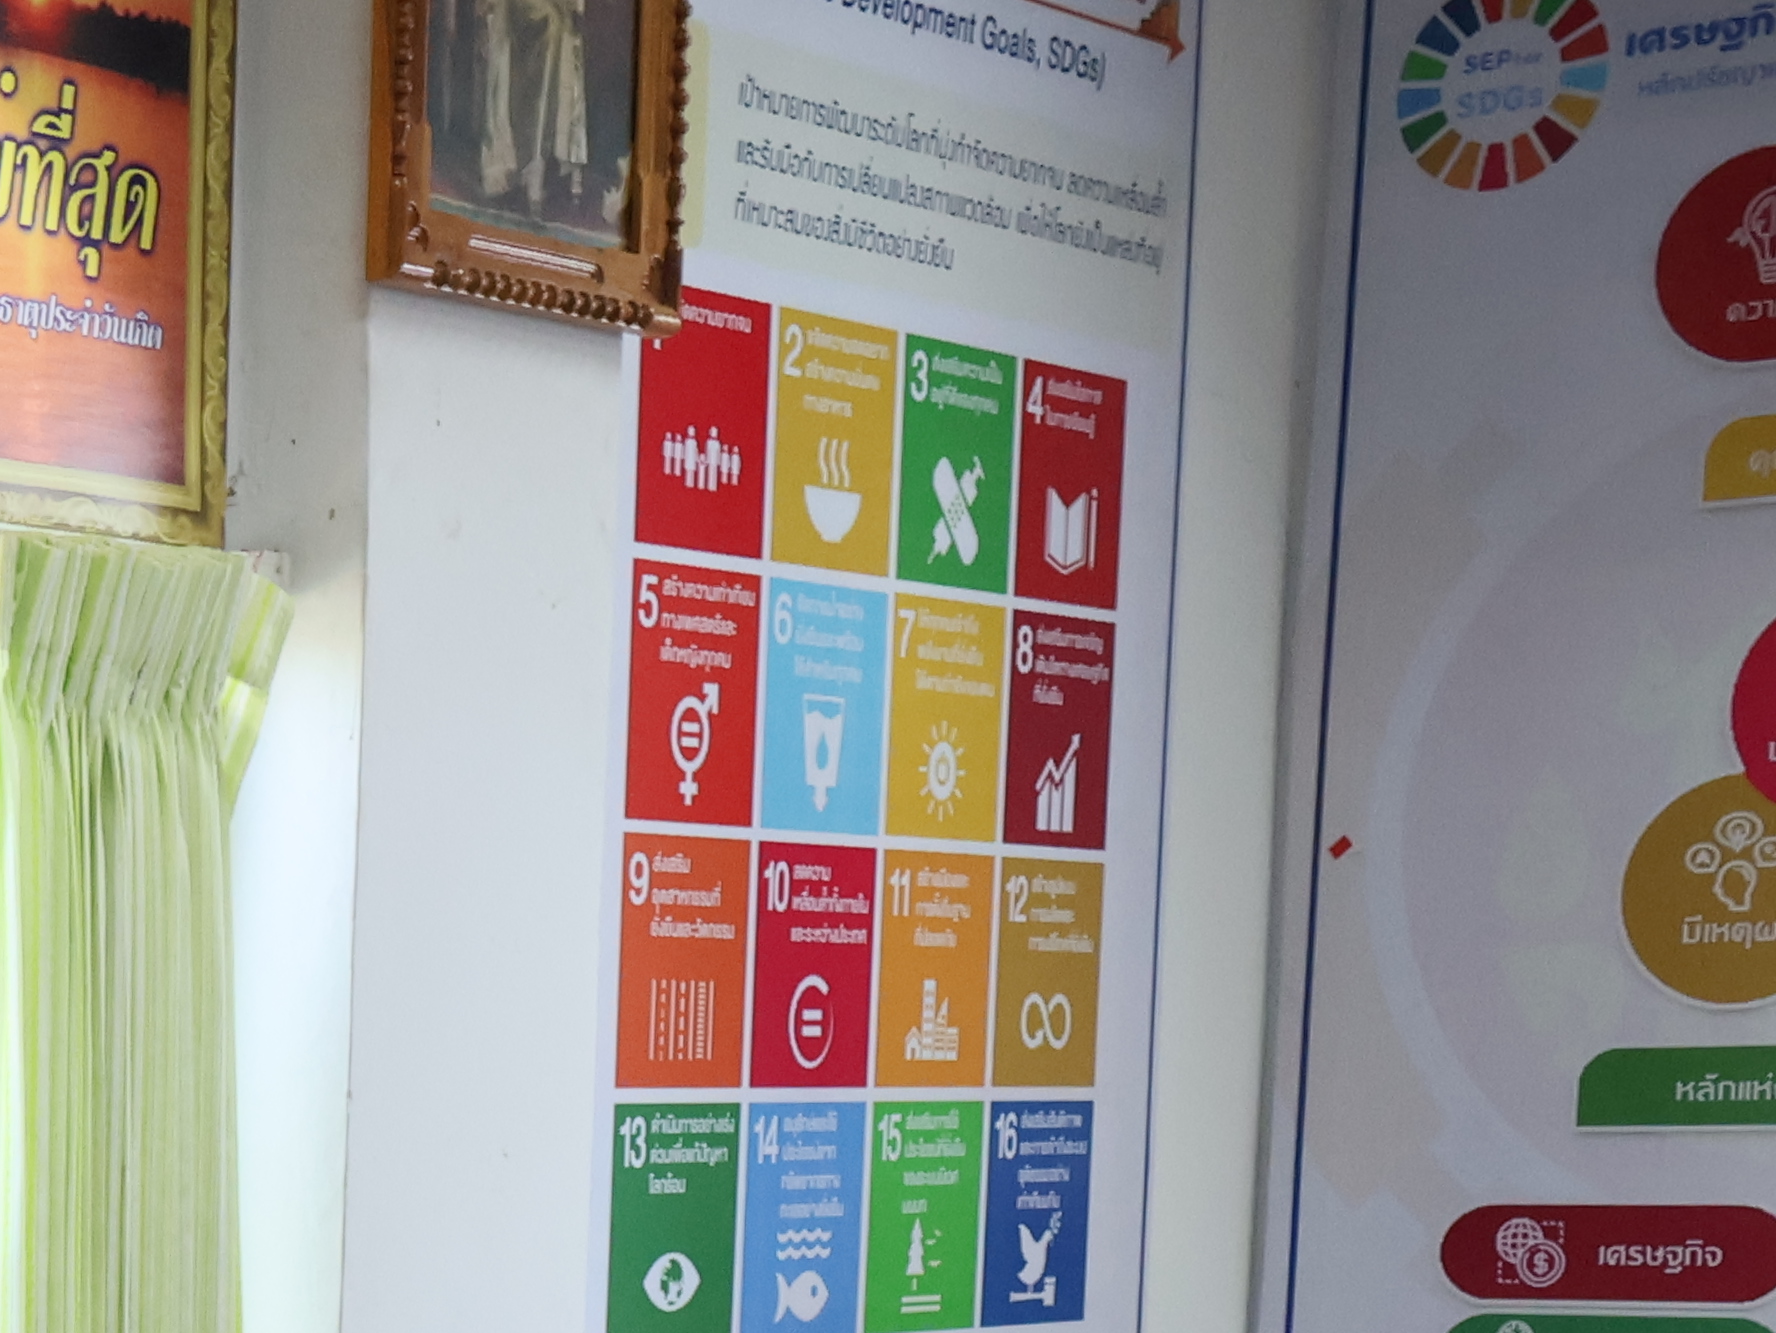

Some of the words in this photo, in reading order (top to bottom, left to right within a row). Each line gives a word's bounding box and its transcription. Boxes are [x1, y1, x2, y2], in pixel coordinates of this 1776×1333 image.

[842, 0, 975, 43] evelopment
[982, 15, 1042, 69] Goals,
[1049, 35, 1107, 91] SDGs)
[1456, 84, 1543, 119] SDGs
[783, 323, 805, 377] 2
[910, 349, 929, 402] 3
[1026, 376, 1044, 424] 4
[638, 574, 660, 628] 5
[774, 592, 793, 645] 6
[897, 609, 916, 658] 7
[1016, 625, 1033, 674] 8
[628, 851, 650, 906] 9
[764, 860, 791, 912] 10
[890, 868, 911, 916] 11
[1005, 875, 1029, 922] 12
[1675, 1072, 1776, 1101] หลักแห่
[619, 1116, 647, 1168] 13
[754, 1115, 780, 1164] 14
[878, 1113, 903, 1161] 15
[995, 1111, 1018, 1159] 16
[1598, 1239, 1725, 1274] เศรษฐกิจ
